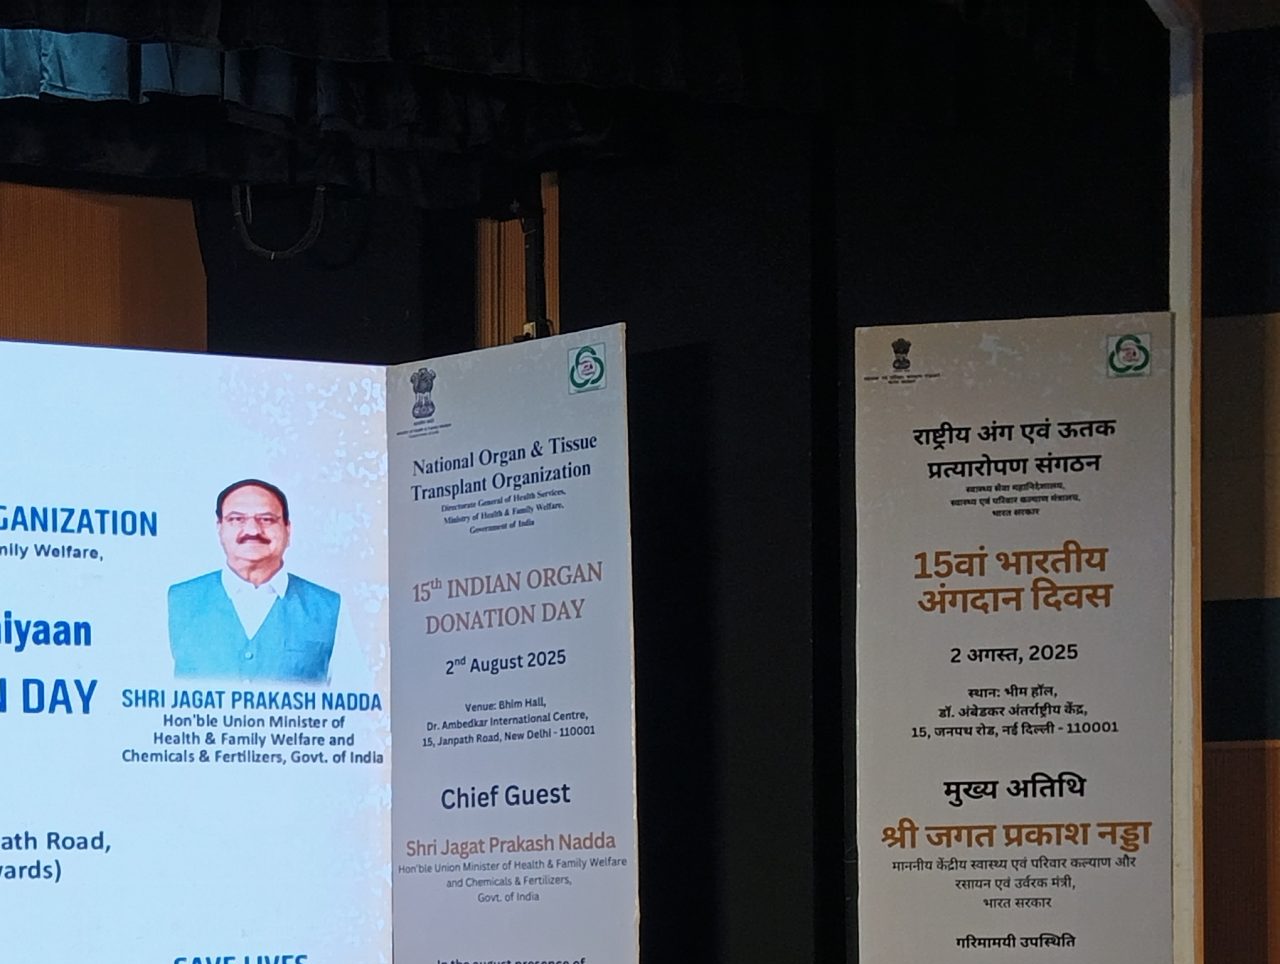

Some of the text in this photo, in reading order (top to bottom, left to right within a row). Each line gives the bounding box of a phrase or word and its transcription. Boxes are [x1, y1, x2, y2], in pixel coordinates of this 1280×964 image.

[913, 419, 1117, 450] राष्ट्रीय अंग एवं ऊतक
[927, 452, 1102, 479] प्रत्यारोपण संगठन
[34, 544, 103, 561] Welfare,
[914, 540, 1109, 579] 15वां भारतीय
[917, 577, 1114, 614] अंगदान दिवस
[950, 644, 1078, 665] 2 अगस्त, 2025
[22, 678, 98, 714] DAY
[122, 689, 382, 711] SHRI JAGAT PRAKASH NADDA
[163, 714, 345, 729] Hon'ble Union Minister of
[154, 731, 354, 748] Health & Family Welfare and
[122, 749, 383, 765] Chemicals & Fertilizers, Govt. of India
[441, 784, 571, 809] Chief Guest
[943, 771, 1087, 807] मुख्य अतिथि
[47, 831, 111, 853] Road,
[406, 831, 616, 860] Shri Jagat Prakash Nadda
[881, 817, 1153, 852] श्री जगत प्रकाश नड्डा
[983, 897, 1052, 908] भारत सरकार
[956, 932, 1076, 948] गरिमामयी उपस्थिति
